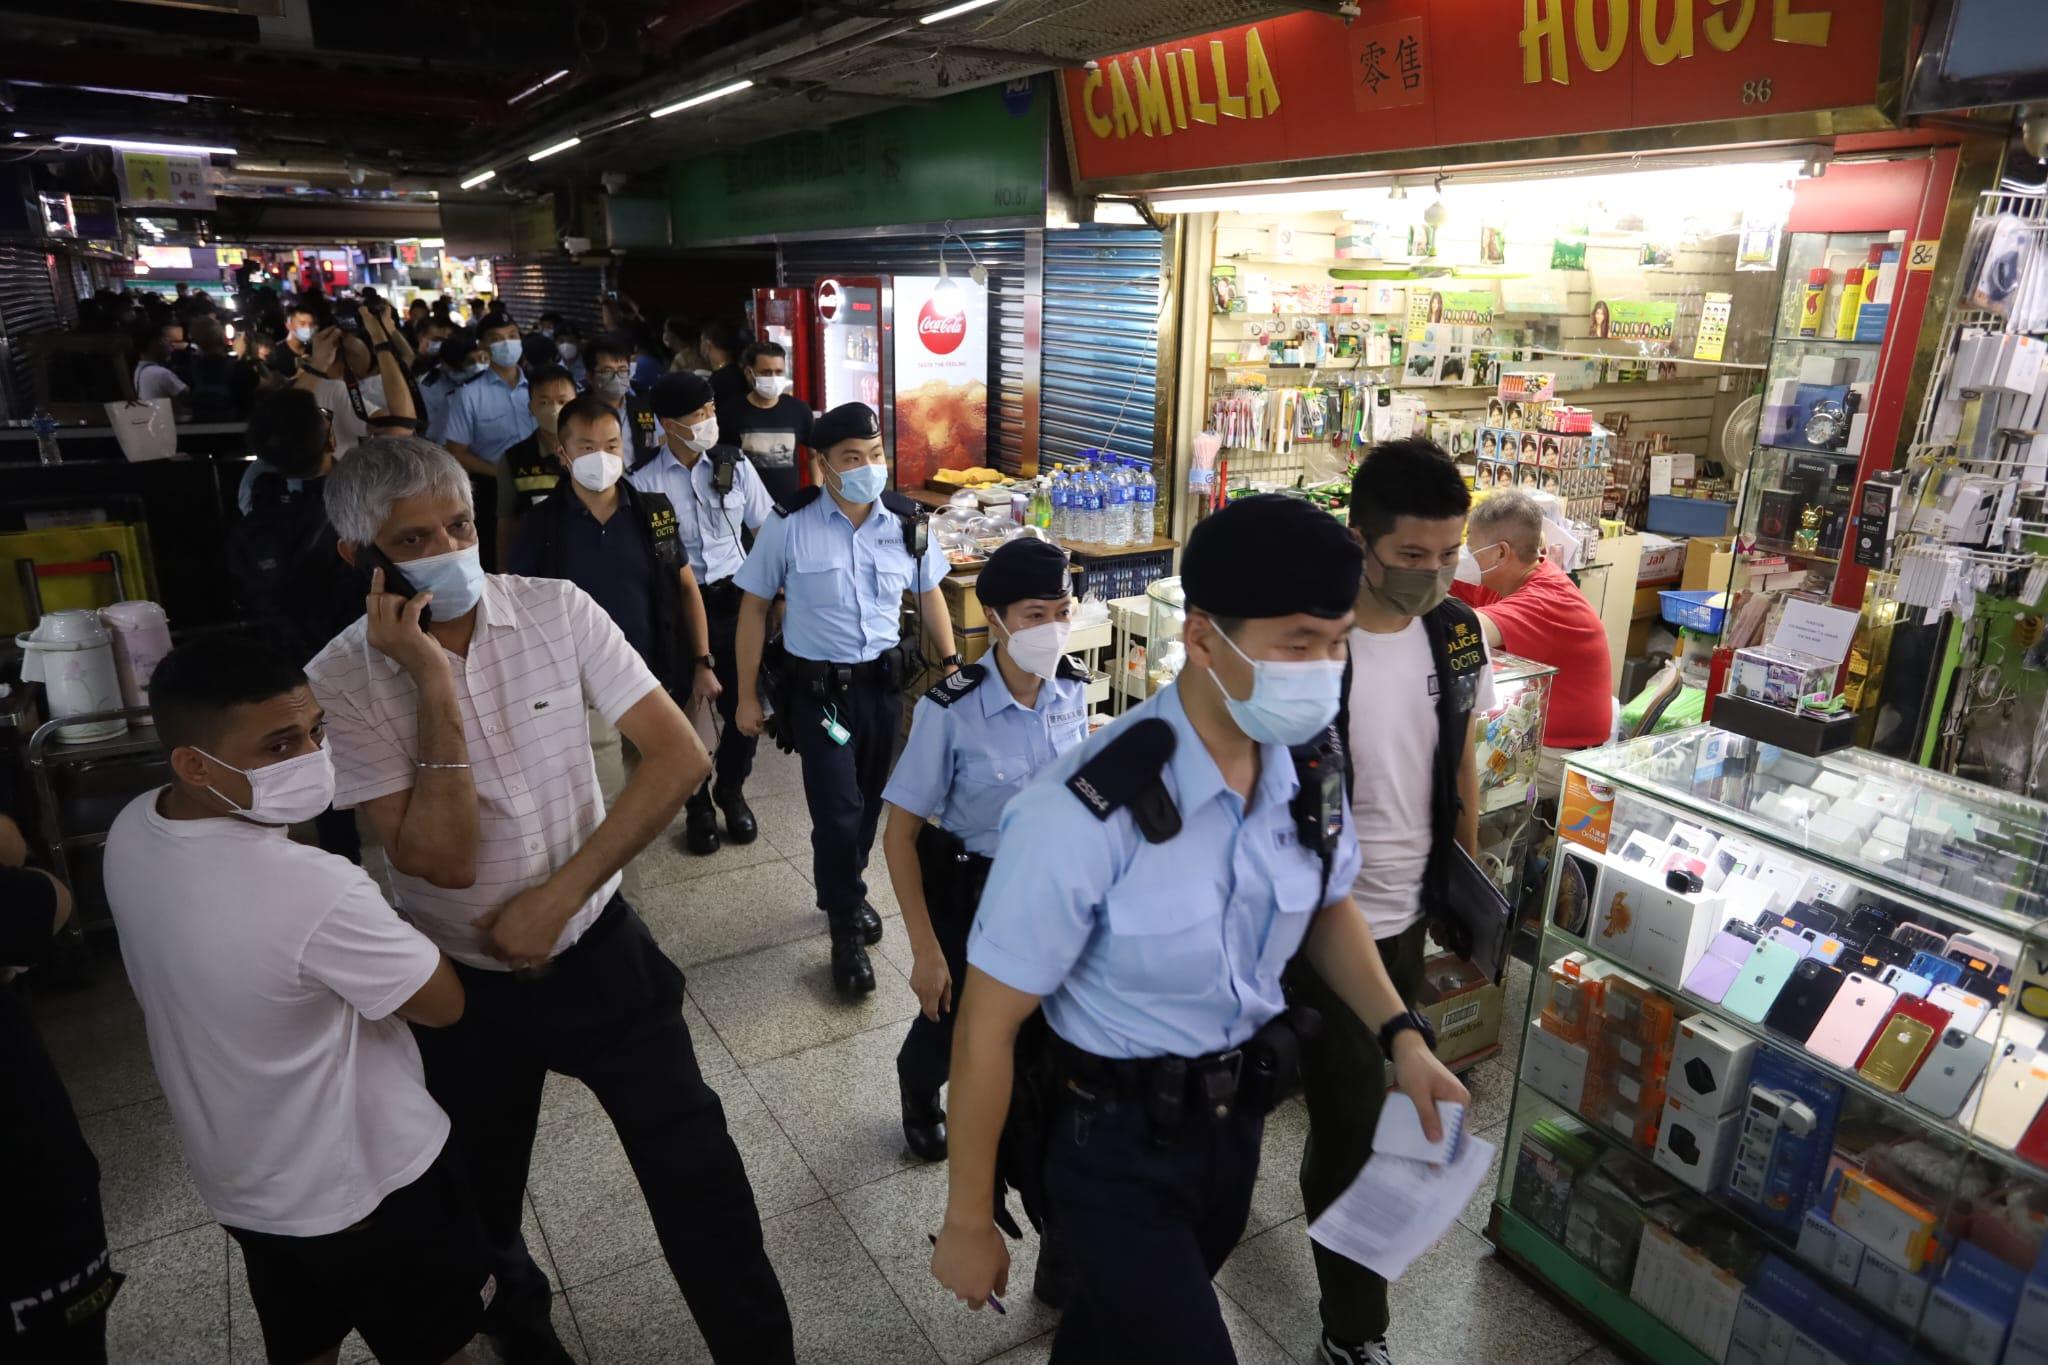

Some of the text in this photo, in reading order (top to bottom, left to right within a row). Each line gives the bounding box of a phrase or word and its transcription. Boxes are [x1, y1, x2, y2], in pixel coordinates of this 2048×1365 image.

[1359, 34, 1423, 97] 零售
[1084, 27, 1282, 139] CAMILLA
[1742, 78, 1772, 105] 86
[1911, 245, 1933, 264] 86
[1447, 633, 1480, 655] OLICE
[1450, 649, 1481, 672] OCTB
